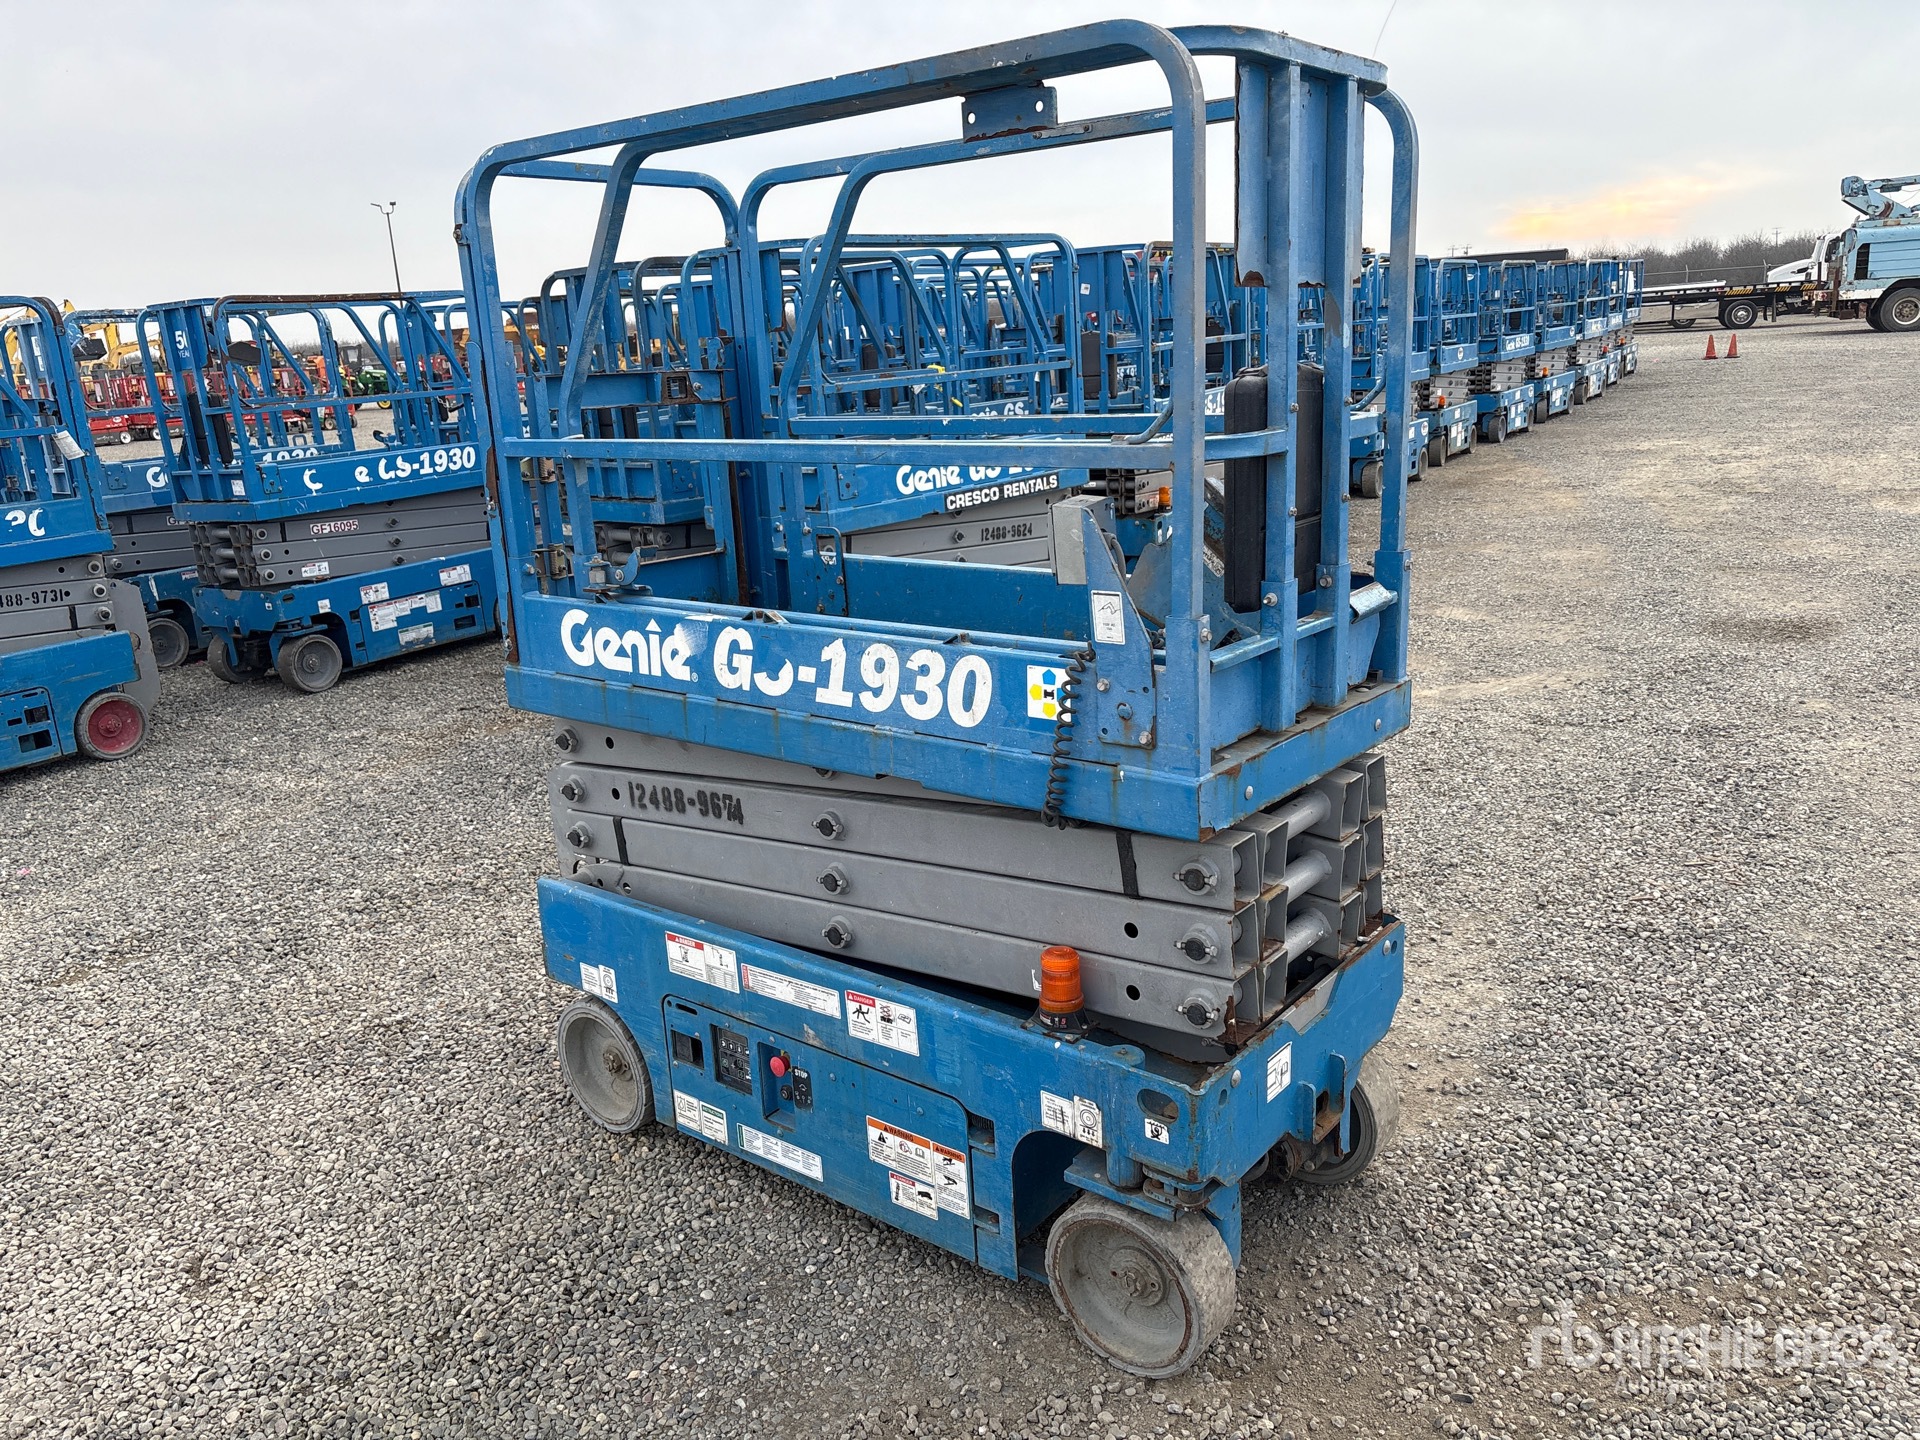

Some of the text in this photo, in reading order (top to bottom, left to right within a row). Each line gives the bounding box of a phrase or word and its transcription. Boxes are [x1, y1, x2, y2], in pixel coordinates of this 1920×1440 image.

[896, 465, 961, 495] Genie
[946, 475, 1058, 510] CRESCO RENTALS
[310, 519, 359, 536] GF16095
[980, 523, 1034, 542] 12488-9624
[560, 608, 691, 682] Genie
[853, 994, 874, 1005] DANGER
[794, 1068, 809, 1080] STOP
[888, 1126, 915, 1143] WARNING
[940, 1147, 963, 1162] WARNING
